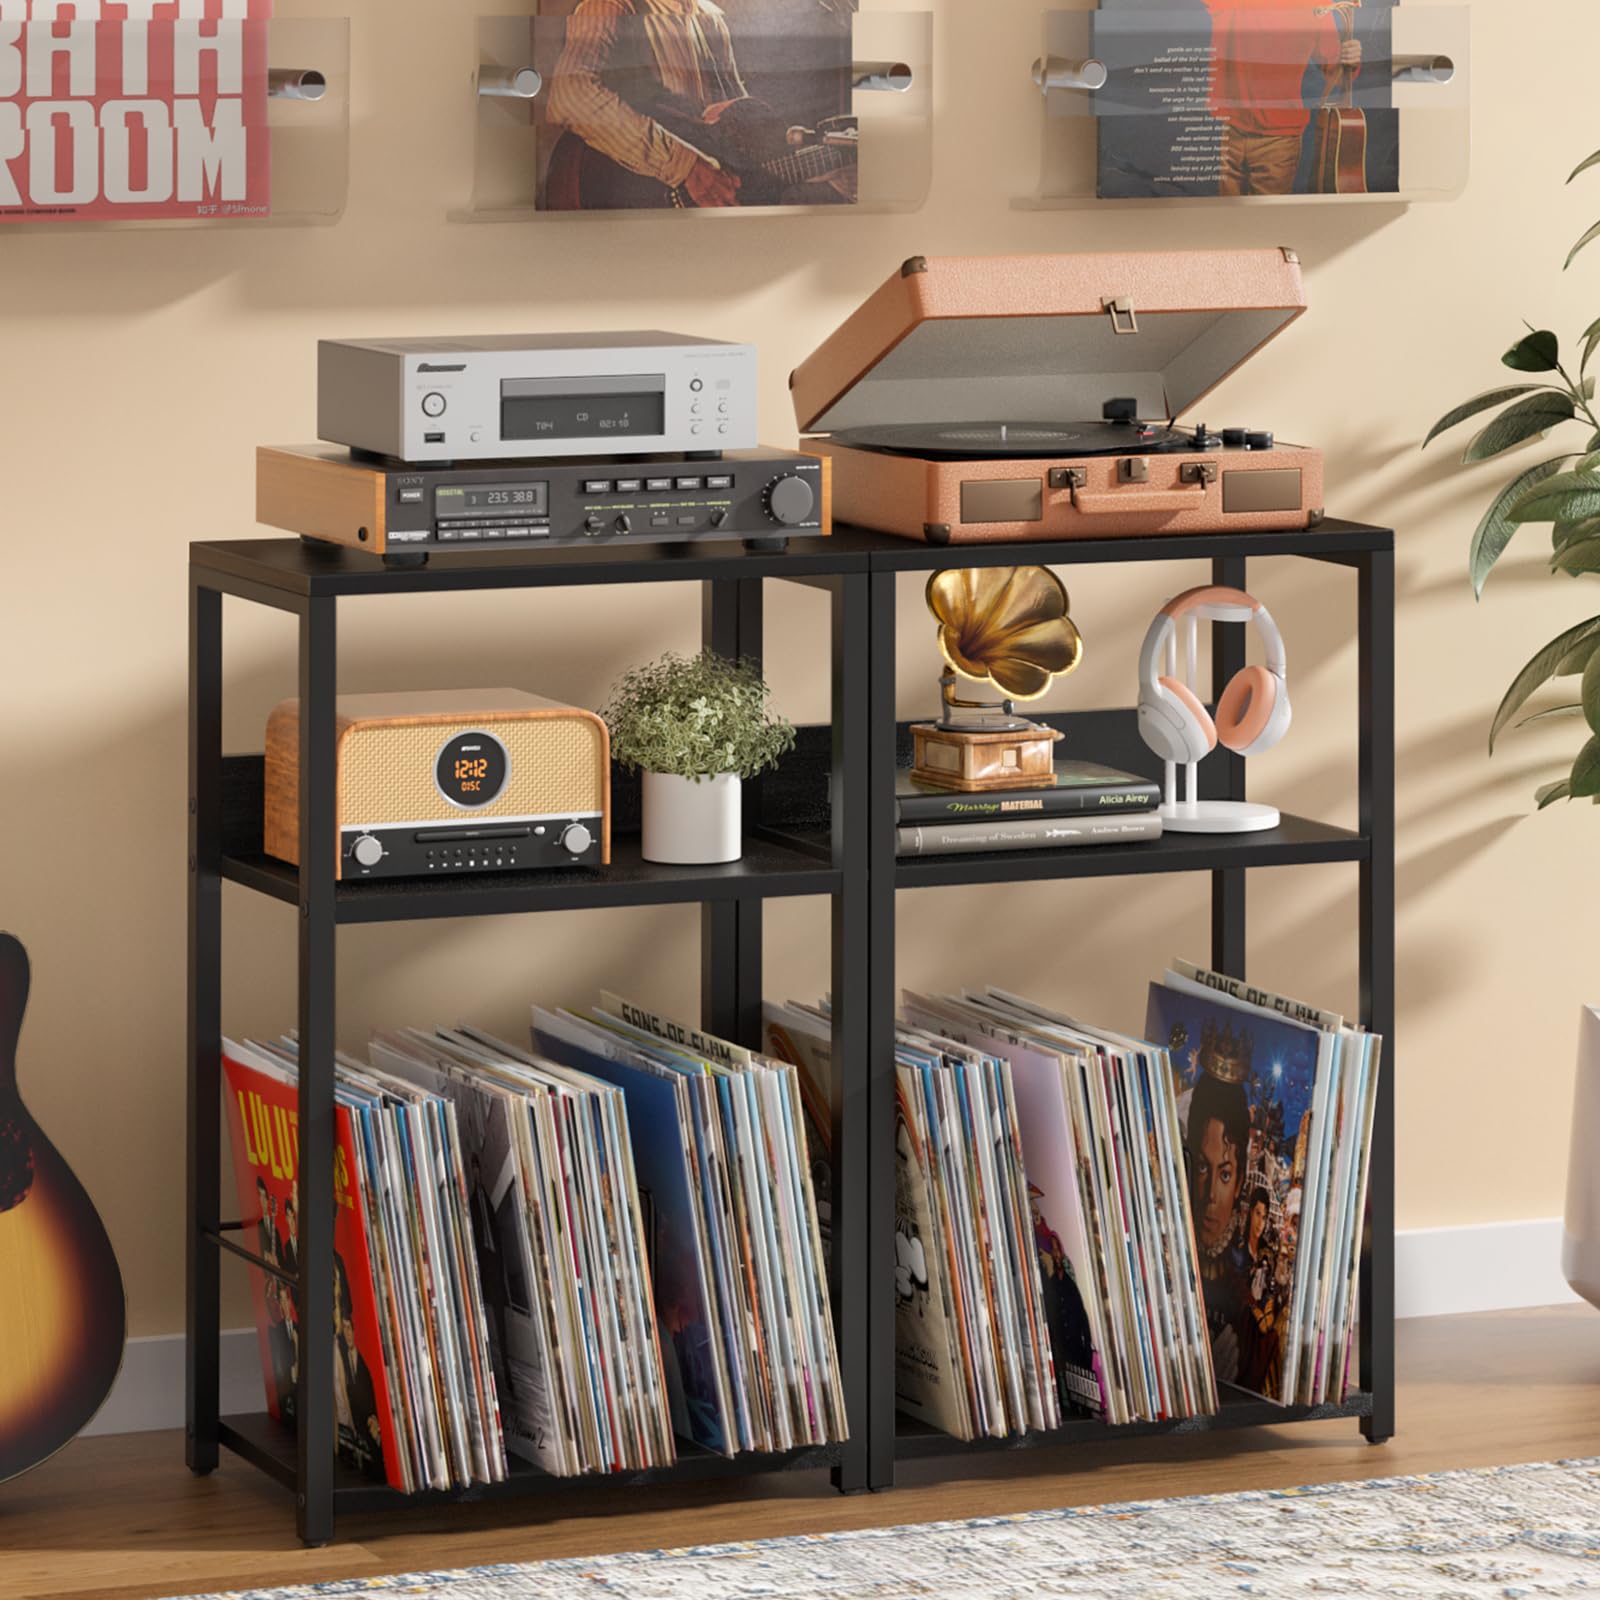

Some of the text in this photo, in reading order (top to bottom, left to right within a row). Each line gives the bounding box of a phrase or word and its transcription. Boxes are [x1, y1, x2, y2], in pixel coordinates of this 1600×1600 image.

[576, 413, 589, 421] CD
[513, 490, 534, 503] 38.8
[454, 758, 488, 779] 12:12
[1001, 799, 1043, 811] MATERIAL
[1099, 794, 1123, 805] Alicia
[1124, 793, 1149, 804] Airey
[1000, 830, 1037, 842] Sweden
